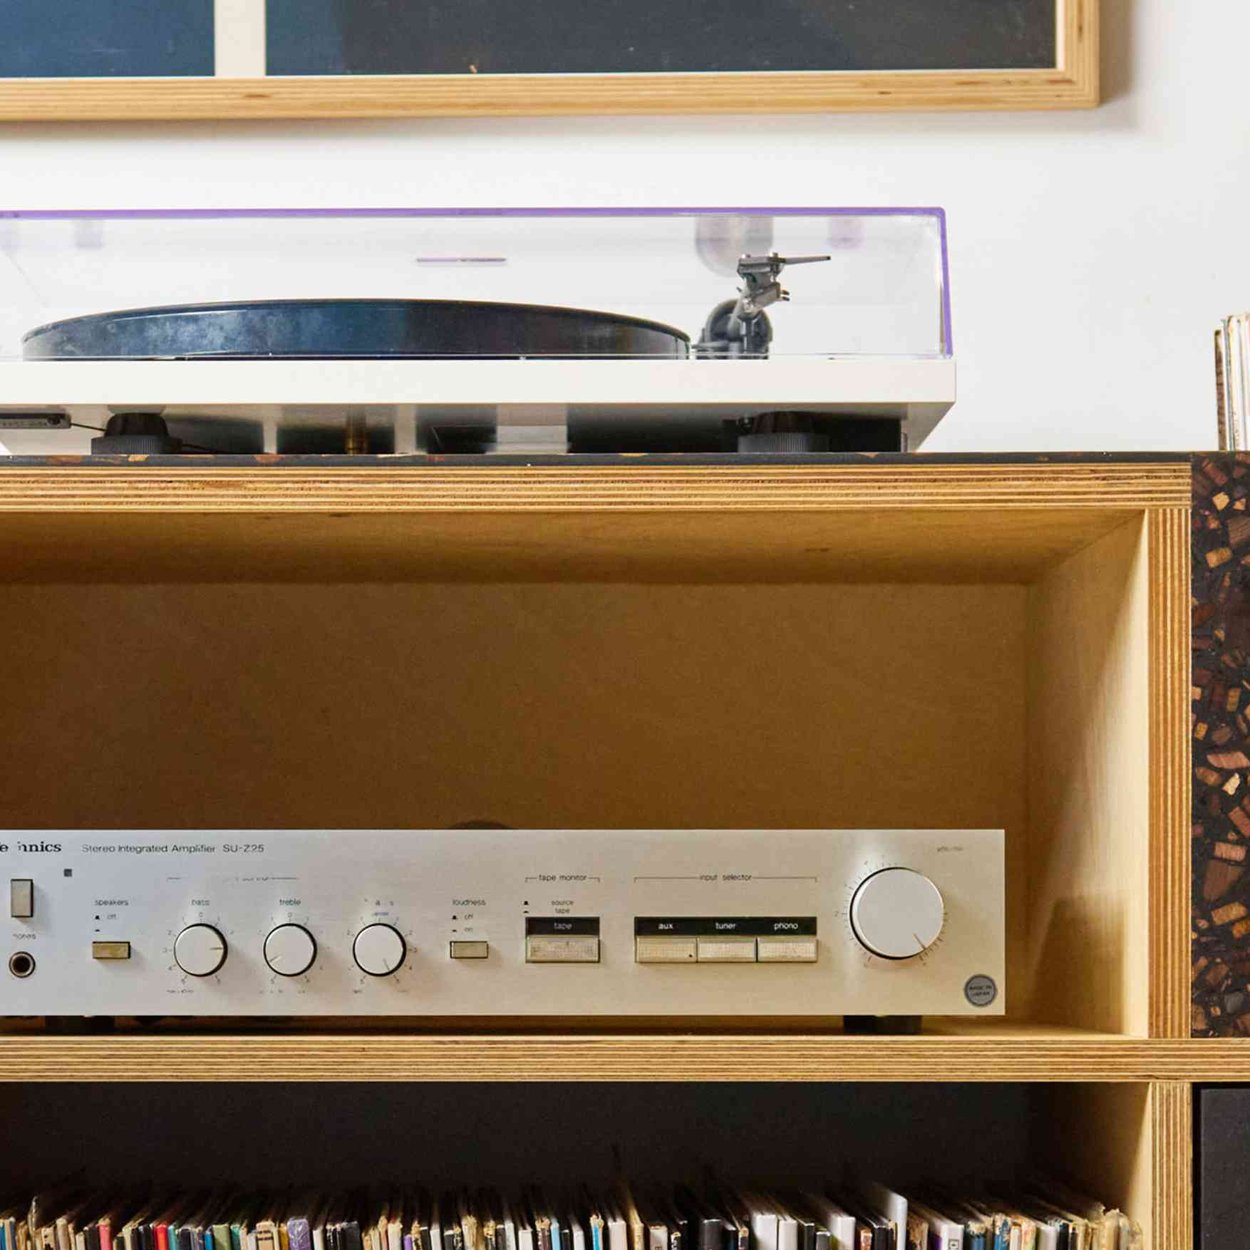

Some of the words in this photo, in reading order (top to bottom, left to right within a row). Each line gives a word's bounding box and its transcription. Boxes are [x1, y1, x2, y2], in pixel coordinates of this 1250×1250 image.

[81, 844, 116, 854] Stereo
[117, 844, 168, 855] Integrated
[171, 844, 216, 854] Amplifier
[538, 874, 556, 882] tape
[722, 873, 752, 881] selector
[94, 899, 129, 907] speakers
[553, 922, 572, 931] tape
[715, 922, 736, 930] tuner
[774, 921, 799, 931] phono
